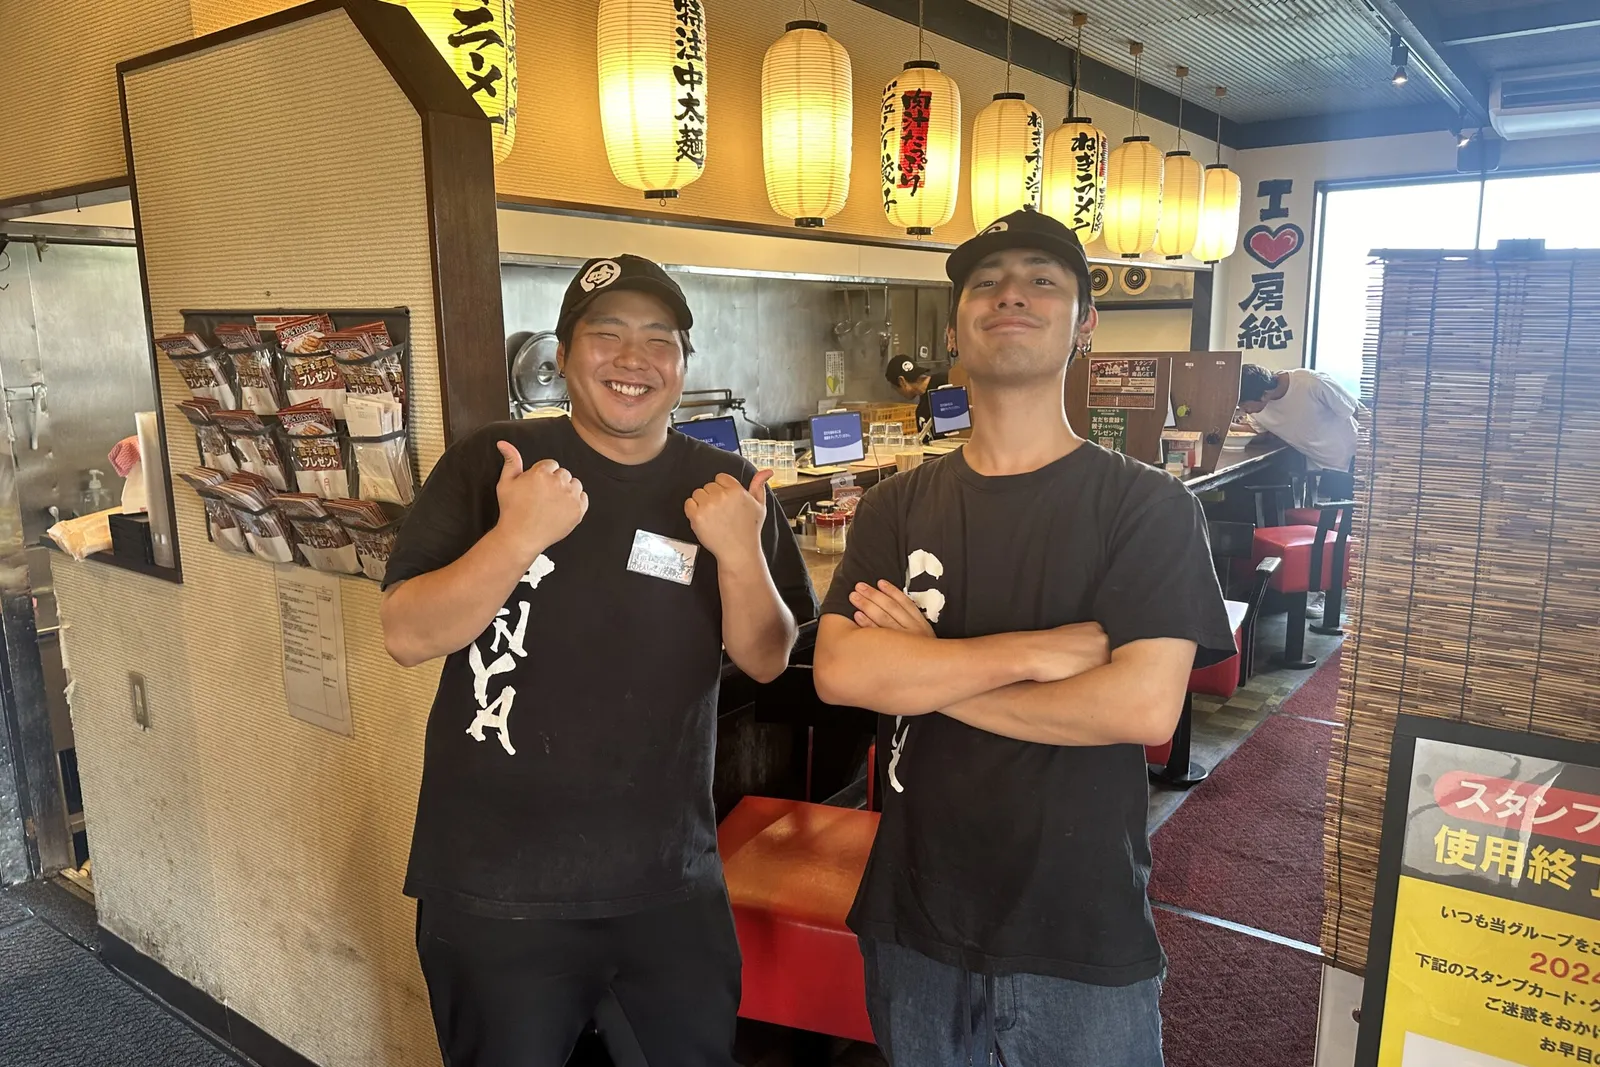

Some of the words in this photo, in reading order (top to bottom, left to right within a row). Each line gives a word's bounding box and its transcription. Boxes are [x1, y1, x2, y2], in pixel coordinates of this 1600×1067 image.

[900, 88, 929, 197] 肉汁たっぷり
[1071, 132, 1096, 231] ねぎラーメン
[1237, 272, 1294, 350] 房総
[299, 368, 338, 387] プレゼント
[302, 456, 339, 468] プレゼント
